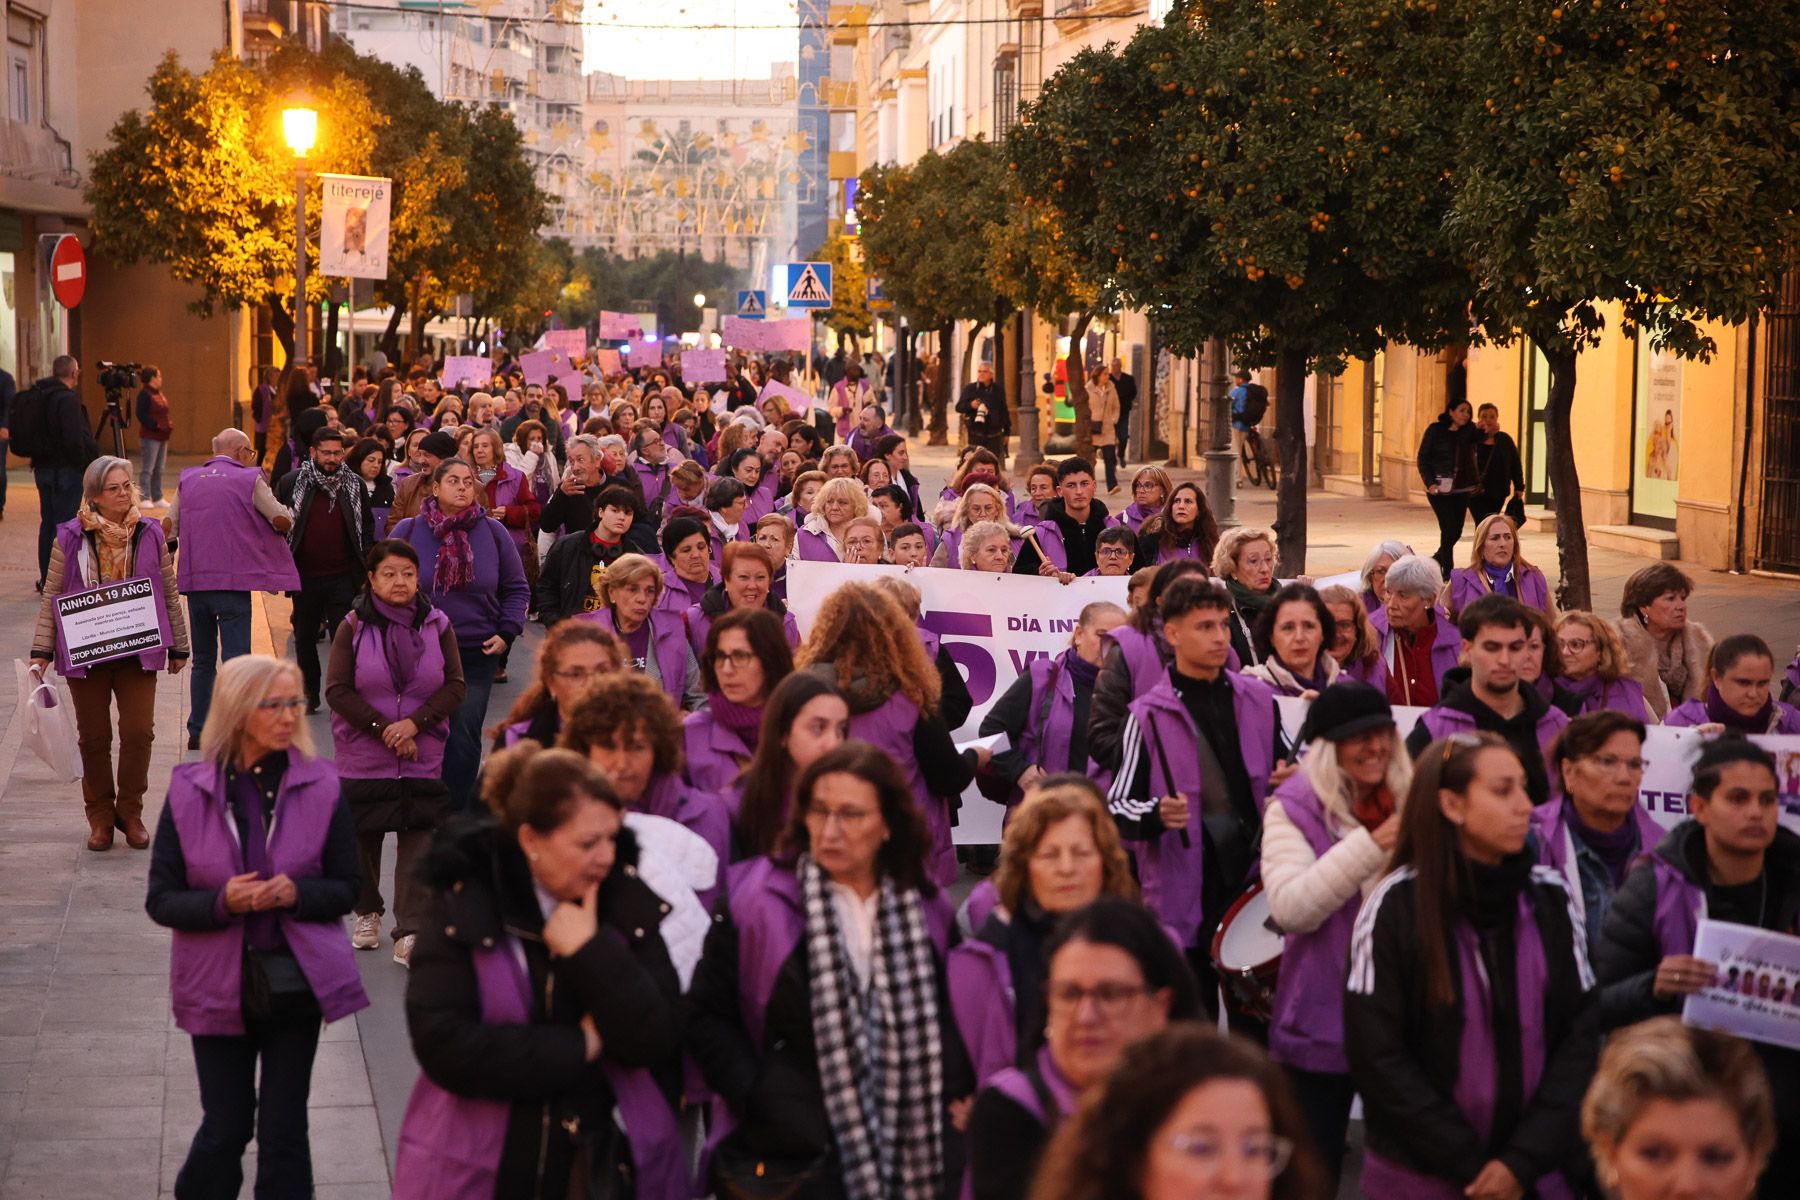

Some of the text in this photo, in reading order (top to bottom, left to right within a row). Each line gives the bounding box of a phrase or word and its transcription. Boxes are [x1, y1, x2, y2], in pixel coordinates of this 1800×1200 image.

[332, 183, 384, 203] titerejé
[60, 582, 151, 612] AINHOA 19 AÑOS
[1007, 613, 1042, 633] DÍA
[70, 633, 160, 661] STOP VIOLENCIA MACHISTA
